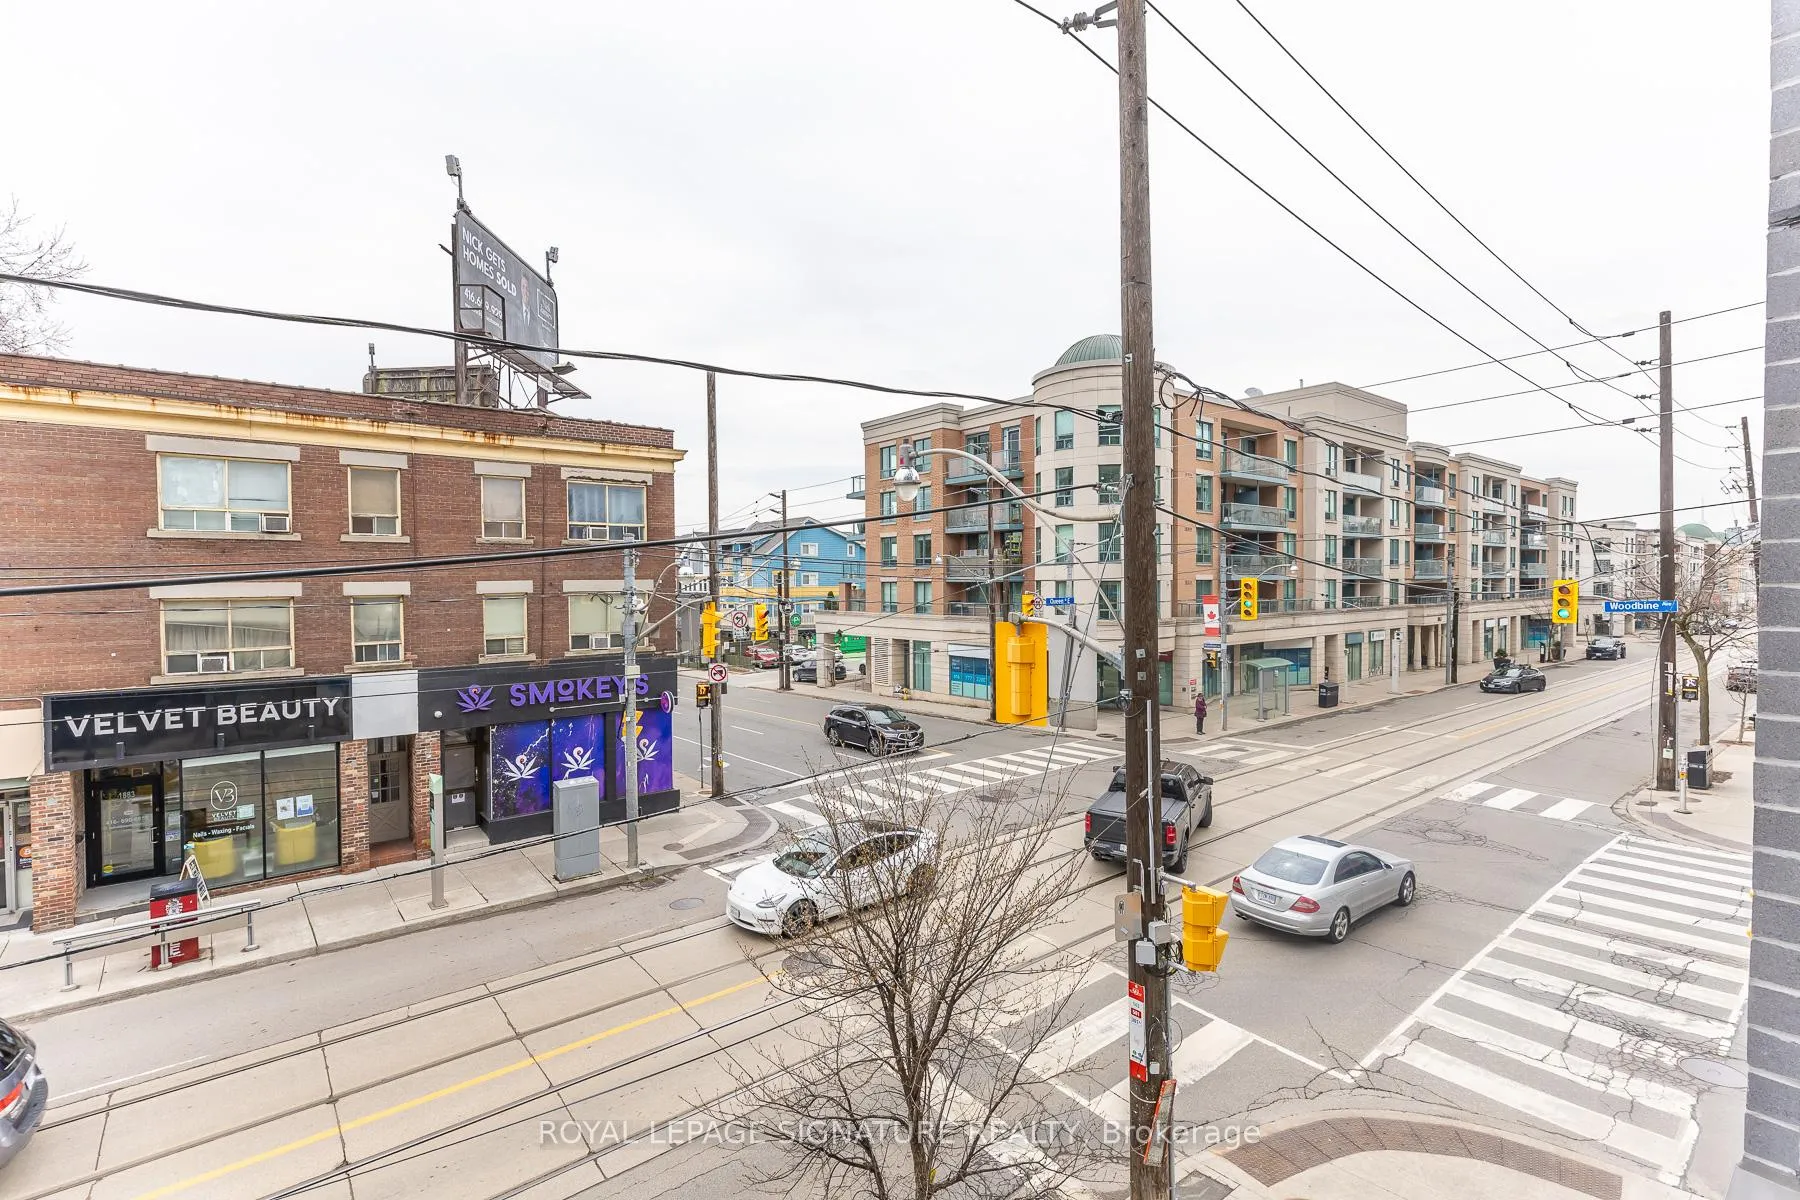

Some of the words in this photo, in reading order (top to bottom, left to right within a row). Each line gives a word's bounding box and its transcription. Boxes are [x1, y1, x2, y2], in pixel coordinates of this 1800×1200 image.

[463, 226, 484, 256] NICK
[486, 247, 506, 273] GETS
[463, 245, 494, 280] HOMES
[496, 271, 517, 297] SOLD
[1609, 601, 1660, 609] Woodbine
[64, 705, 207, 738] VELVET
[217, 696, 341, 726] BEAUTY
[212, 810, 237, 818] VELVET
[192, 830, 207, 838] Nails
[211, 826, 232, 836] Waxing
[235, 823, 255, 832] Facials
